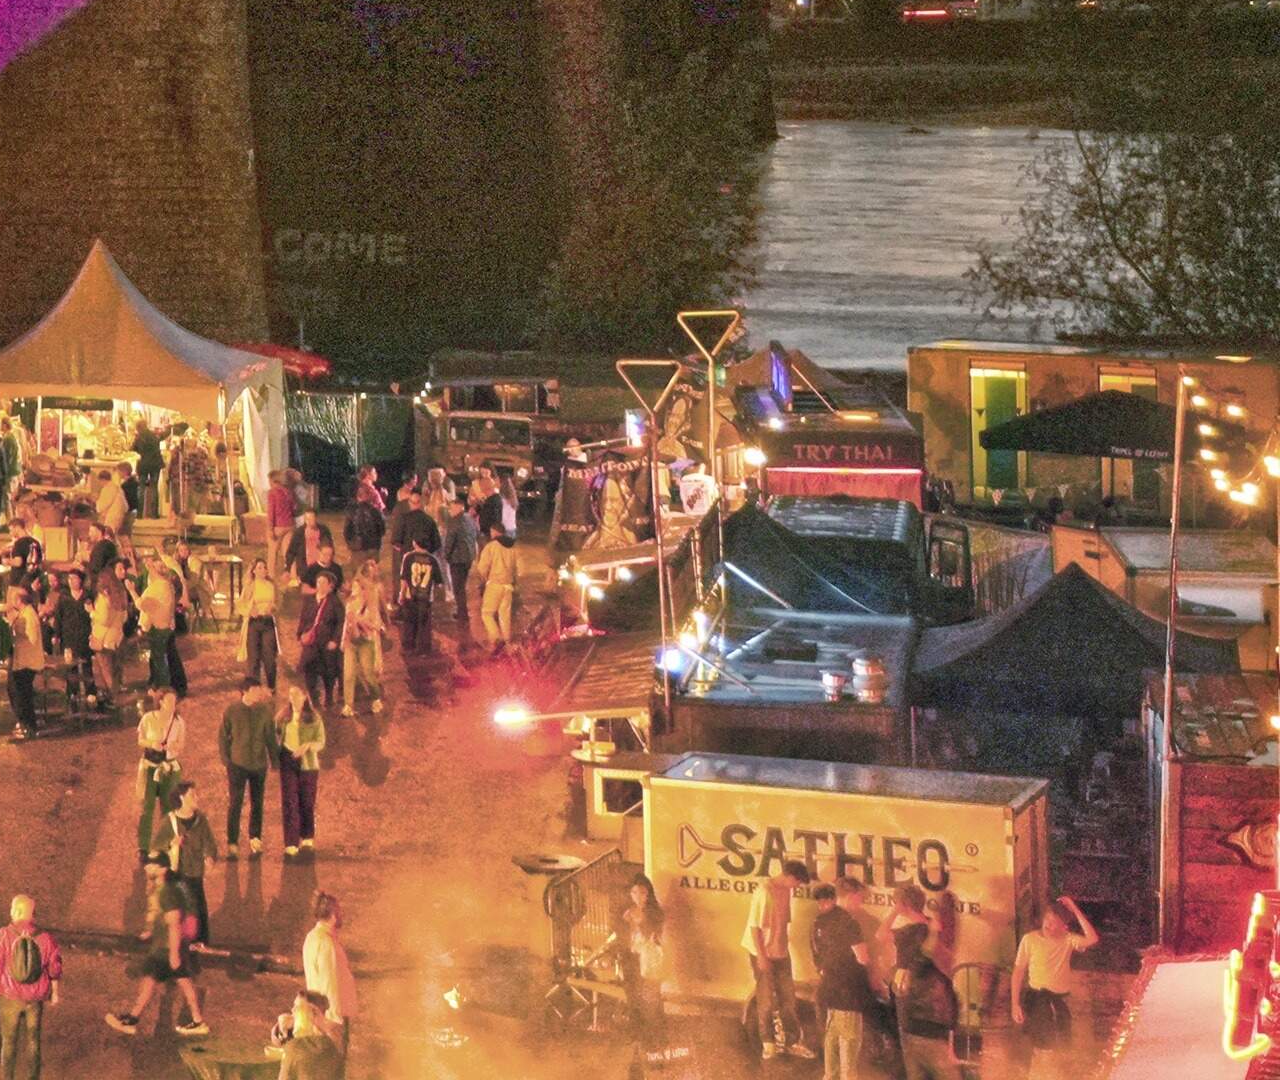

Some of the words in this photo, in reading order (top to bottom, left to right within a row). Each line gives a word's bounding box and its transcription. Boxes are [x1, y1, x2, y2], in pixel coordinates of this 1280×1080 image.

[793, 444, 836, 461] TRY
[841, 444, 893, 461] THAI
[411, 561, 433, 588] 87
[716, 823, 951, 893] SATHEO
